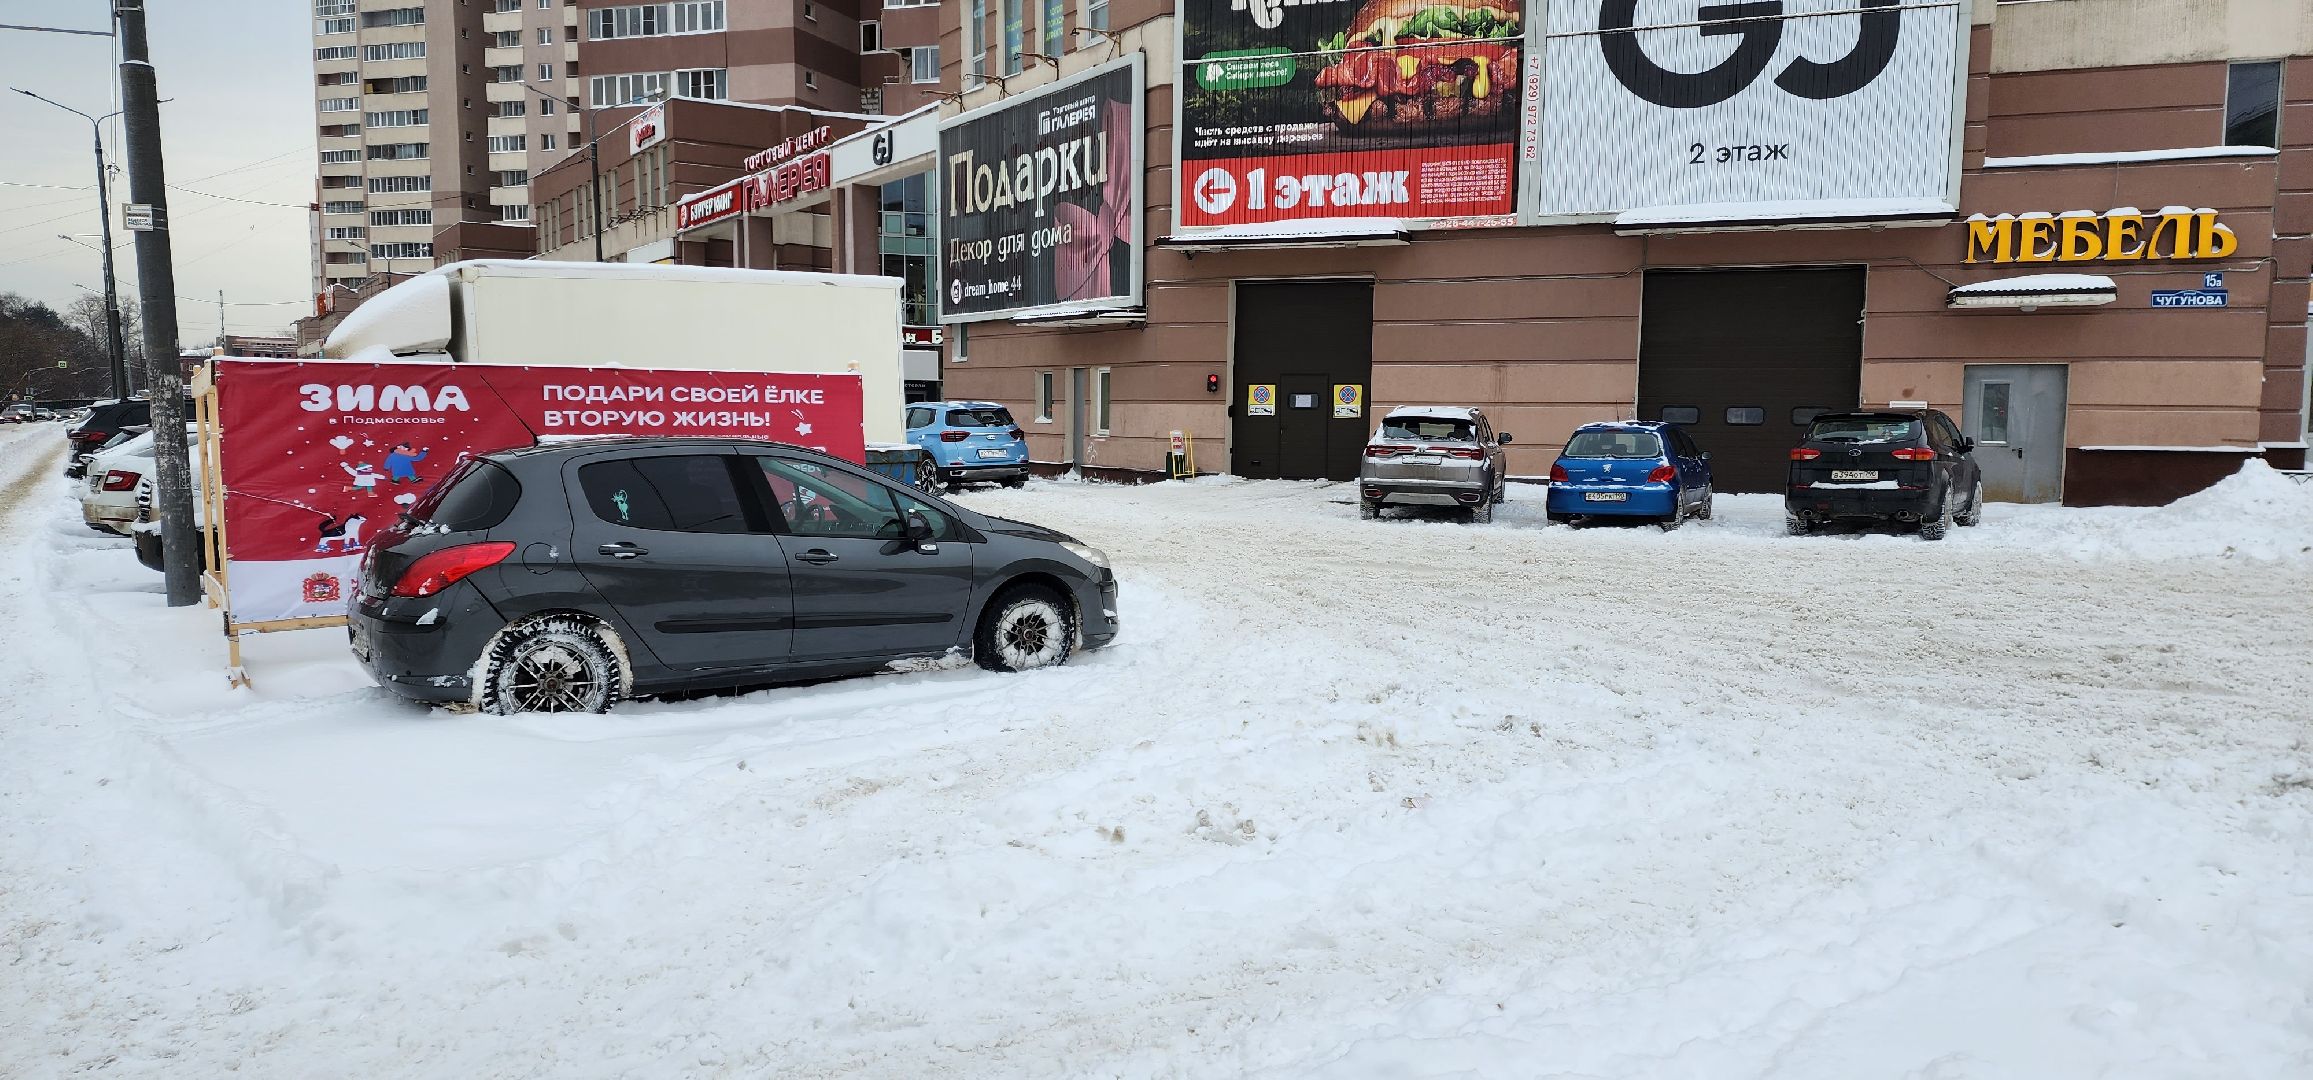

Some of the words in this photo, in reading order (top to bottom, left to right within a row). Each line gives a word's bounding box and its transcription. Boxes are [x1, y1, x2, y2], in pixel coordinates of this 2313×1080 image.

[1527, 74, 1540, 102] (929)
[1051, 104, 1096, 132] ГАЛЕРЕЯ
[1527, 105, 1537, 126] 972
[1220, 139, 1231, 147] на
[1225, 125, 1264, 138] средств
[1526, 129, 1537, 143] 73
[744, 136, 793, 172] ТОРГОВЫЙ
[795, 125, 831, 152] ЦЕНТР
[872, 129, 894, 166] GJ
[1525, 145, 1536, 159] 62
[1689, 142, 1706, 165] 2
[1715, 142, 1790, 164] этаж
[742, 152, 831, 213] ГАЛЕРЕЯ
[949, 130, 1109, 218] Подарки
[1246, 167, 1266, 210] 1
[1274, 170, 1410, 209] этаж
[690, 197, 713, 222] БУРГЕР
[949, 237, 993, 266] Декор
[997, 231, 1026, 263] для
[1031, 222, 1073, 258] дома
[1960, 212, 2238, 264] МЕБЕЛЬ
[964, 275, 1022, 299] dream_home_44
[2156, 295, 2223, 306] ЧУГУНОВА
[299, 383, 471, 412] ЗИМА
[542, 385, 665, 405] ПОДАРИ
[670, 384, 759, 404] СВОЕЙ
[764, 385, 825, 405] ЁЛКЕ
[328, 417, 337, 425] в
[343, 415, 446, 426] Подмосковье
[543, 409, 666, 428] ВТОРУЮ
[673, 411, 771, 428] ЖИЗНЬ!
